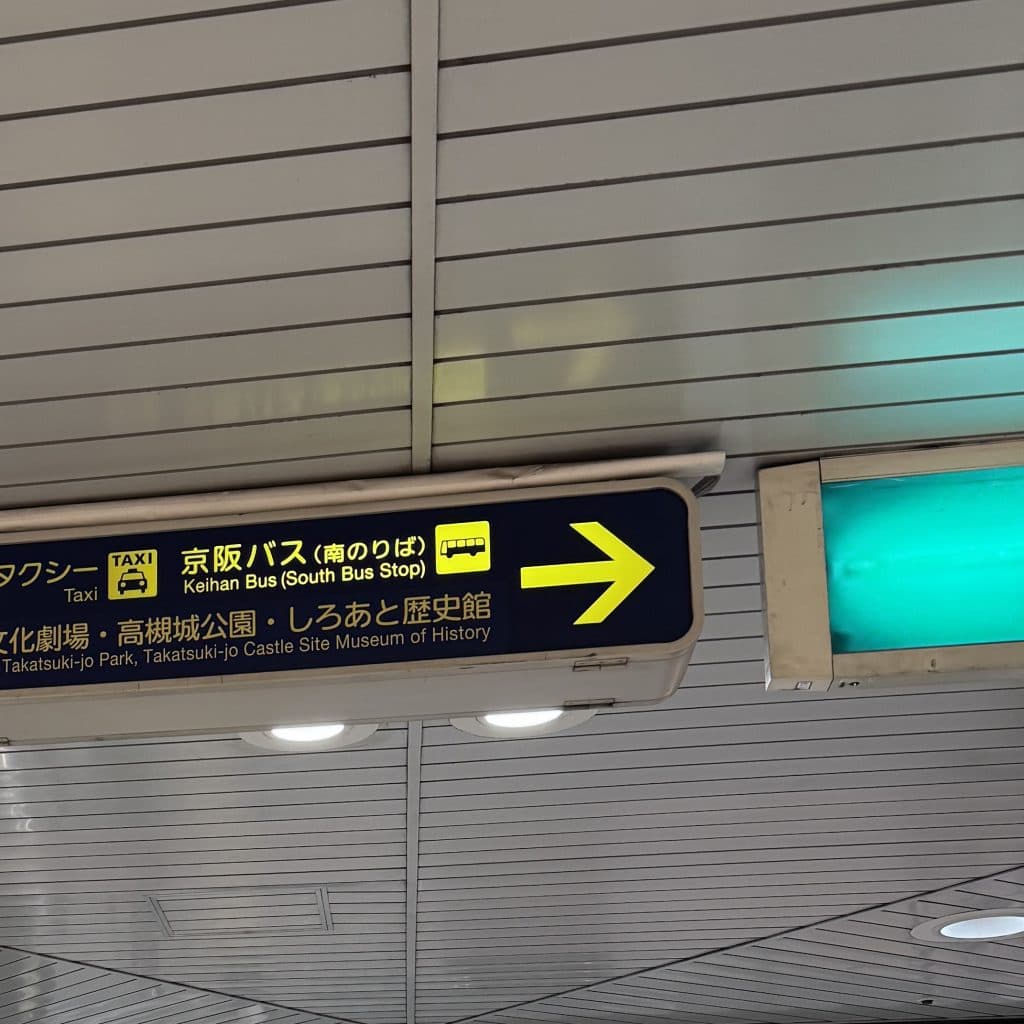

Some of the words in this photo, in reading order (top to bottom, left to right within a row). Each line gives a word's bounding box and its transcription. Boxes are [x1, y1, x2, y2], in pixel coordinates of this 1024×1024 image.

[112, 552, 153, 567] TAXI
[184, 574, 239, 594] Keihan
[246, 572, 277, 589] Bus
[280, 568, 335, 590] (South
[341, 564, 374, 581] Bus
[379, 559, 426, 581] Stop)
[63, 586, 98, 604] Taxi
[2, 652, 94, 674] Takatsuki-jo
[99, 649, 137, 669] Park,
[143, 644, 239, 666] Takatsuki-jo
[244, 639, 294, 657] Castle
[298, 637, 330, 654] Site
[335, 631, 405, 650] Museum
[410, 628, 427, 645] of
[432, 625, 491, 647] History
